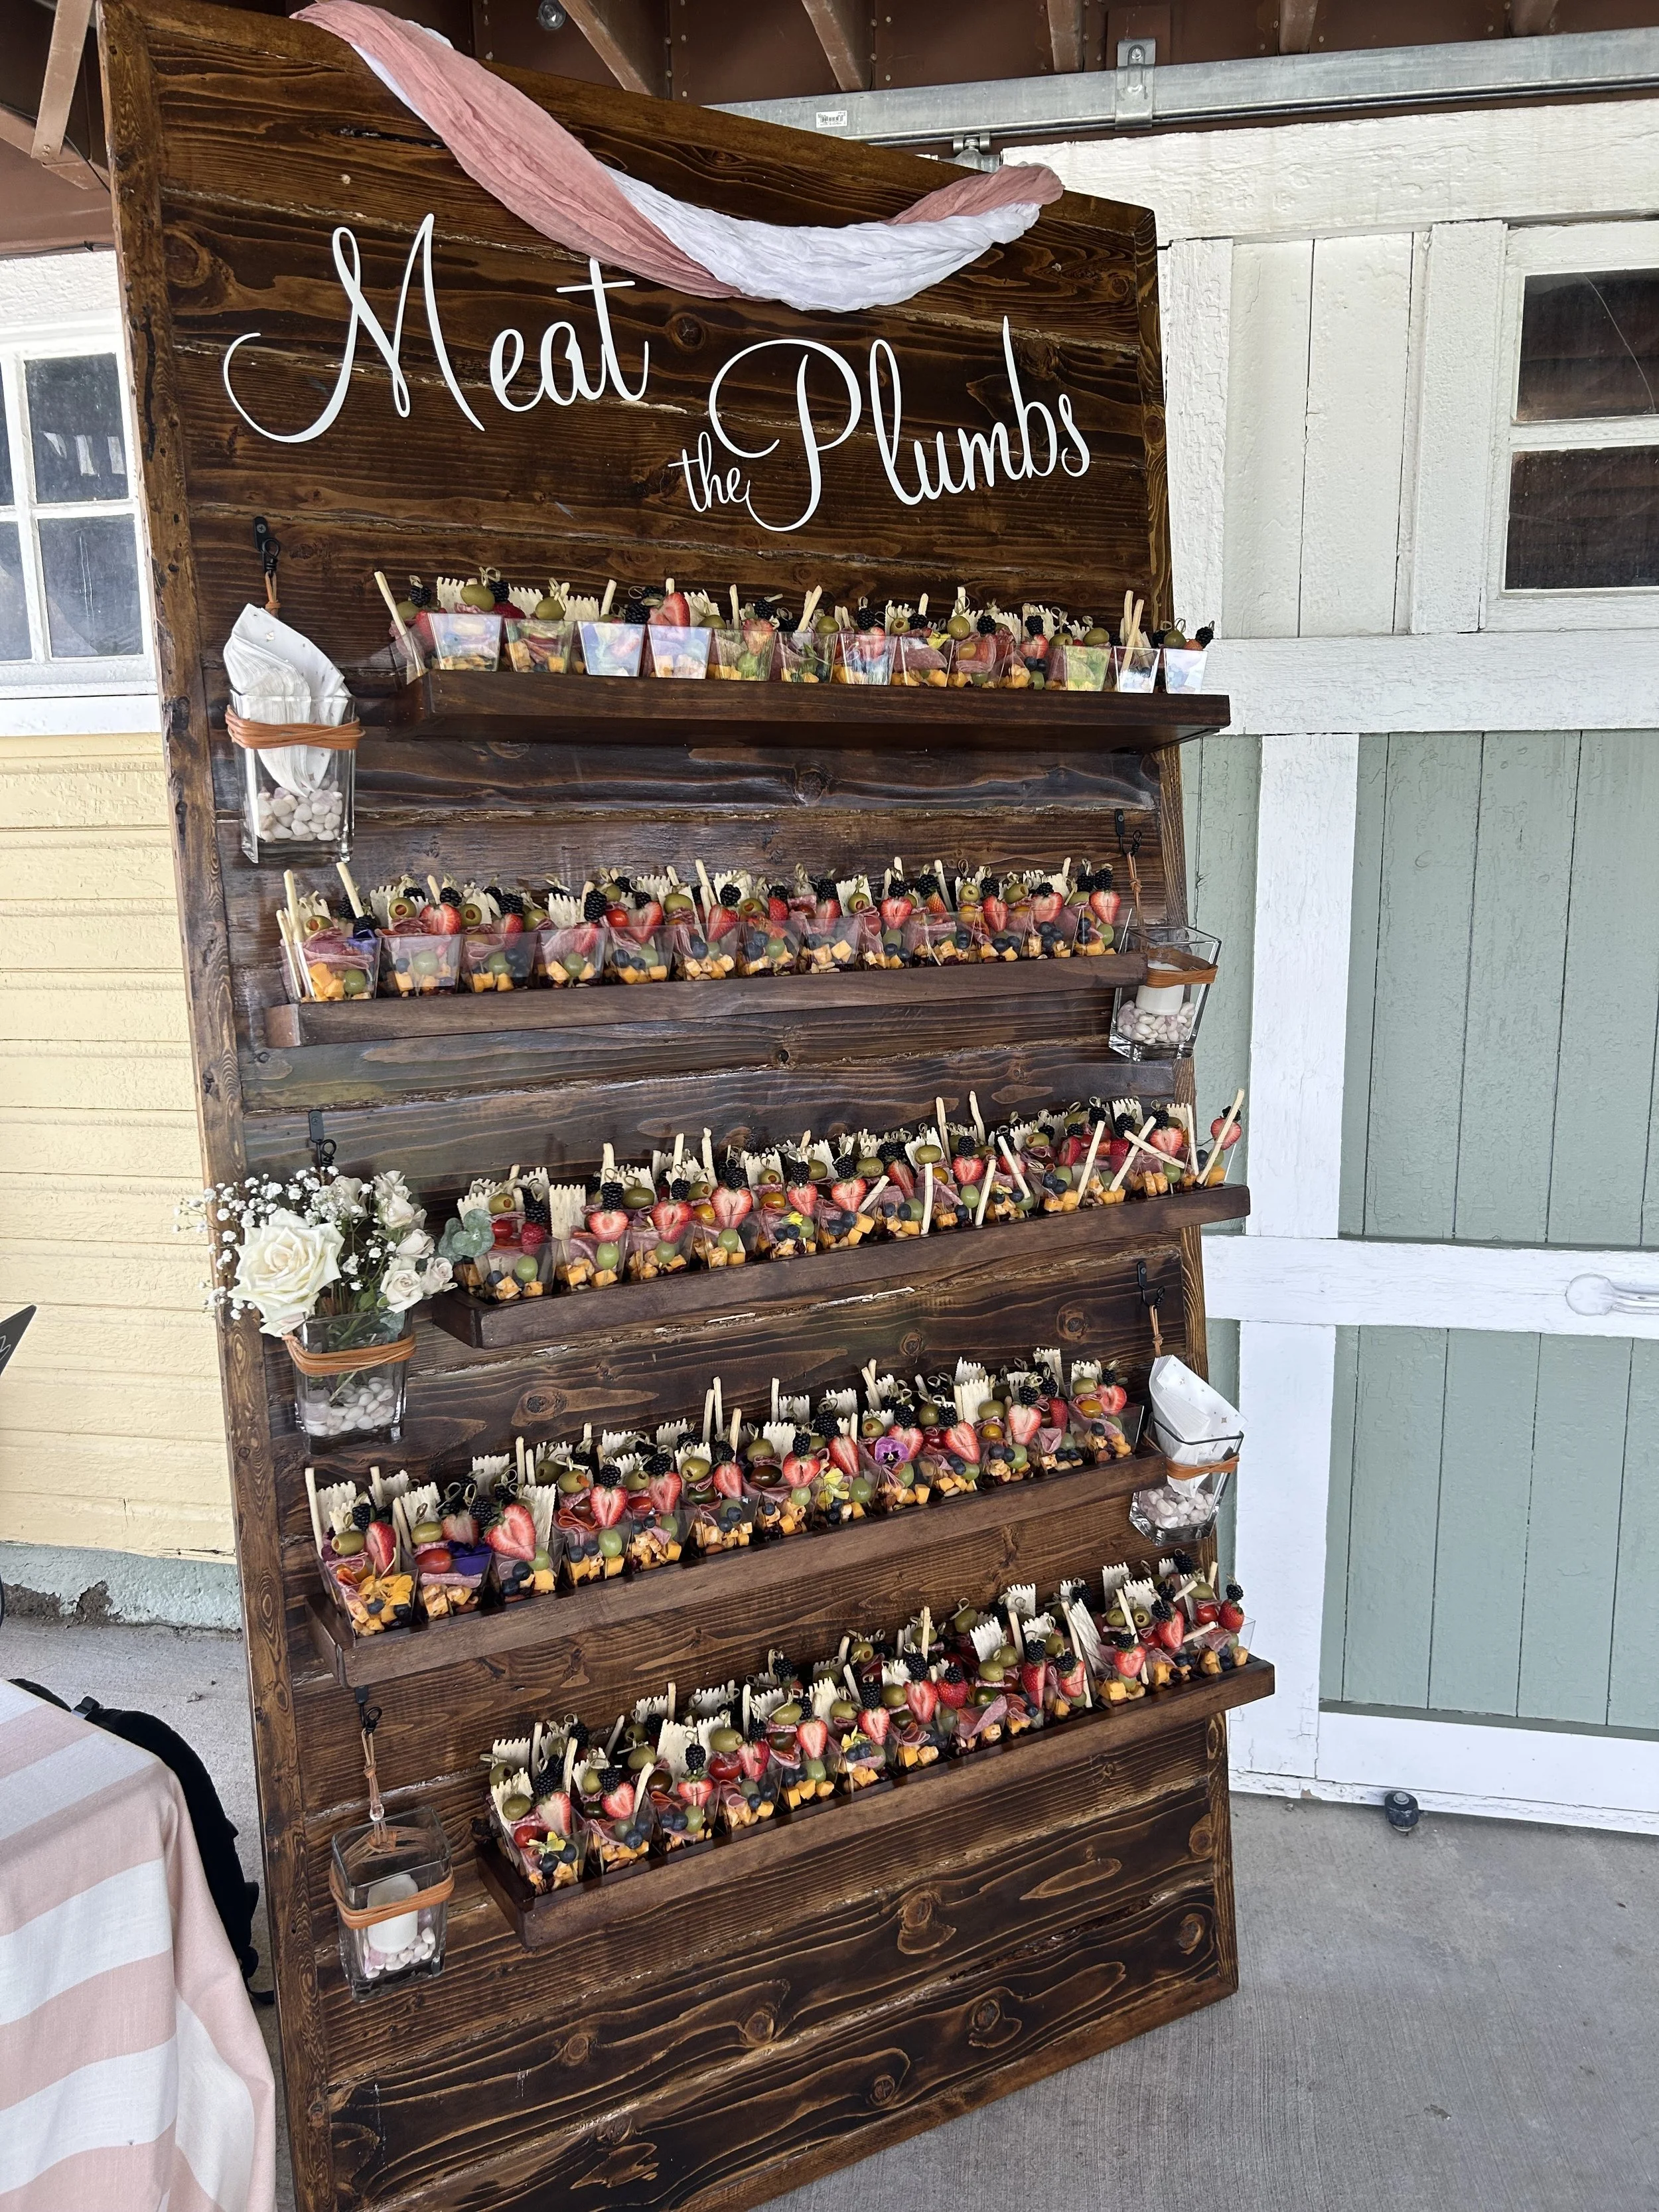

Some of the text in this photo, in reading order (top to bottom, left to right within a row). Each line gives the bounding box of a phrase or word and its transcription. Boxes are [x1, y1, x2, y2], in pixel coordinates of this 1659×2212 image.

[224, 213, 650, 443] Meat
[668, 315, 1090, 532] the Plumbs
